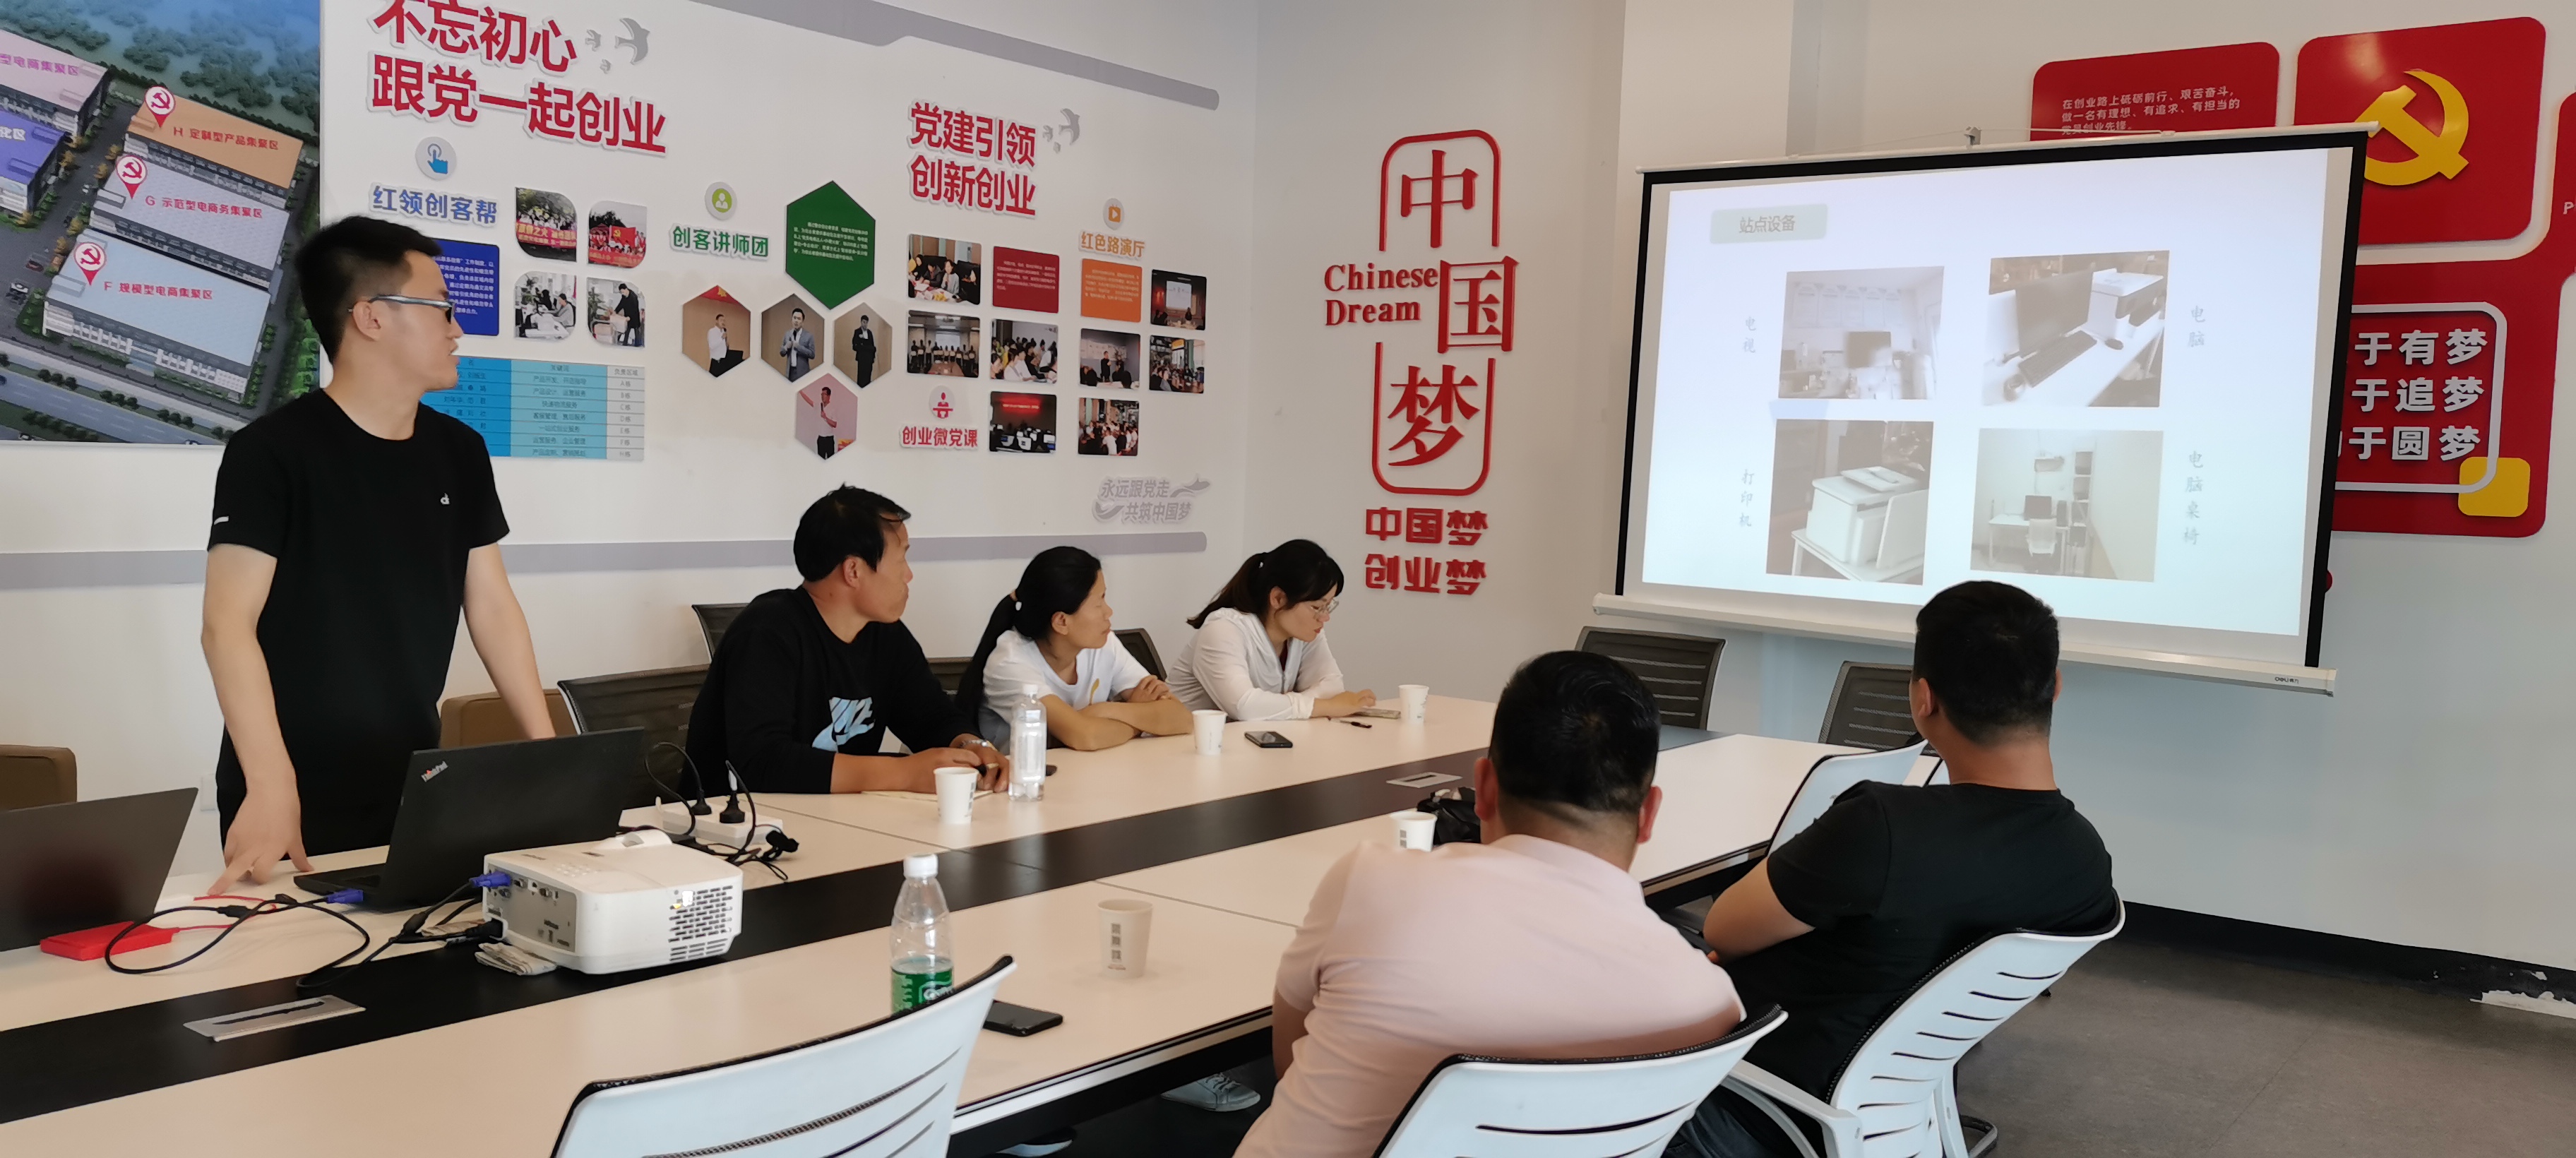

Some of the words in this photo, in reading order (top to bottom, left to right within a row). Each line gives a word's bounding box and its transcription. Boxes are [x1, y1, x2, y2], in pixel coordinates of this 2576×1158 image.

[373, 0, 578, 73] 不忘初心
[372, 54, 666, 153] 跟党一起创业
[173, 126, 184, 137] H
[910, 102, 1036, 167] 党建引领
[145, 195, 155, 205] G
[910, 155, 1036, 215] 创新创业
[373, 185, 497, 224] 红领创客帮
[1739, 214, 1795, 234] 站点设备
[673, 225, 768, 258] 创客讲师团
[1081, 231, 1145, 258] 红色路演厅
[104, 281, 112, 291] F
[1324, 262, 1439, 292] Chinese
[1325, 298, 1421, 326] Dream
[2354, 328, 2488, 366] 于有梦
[2351, 376, 2485, 413] 于追梦
[902, 426, 978, 448] 创业微党课
[2338, 426, 2481, 461] 于圆梦
[1100, 479, 1171, 499] 永远跟党走
[1121, 501, 1192, 522] 共筑中国梦
[1365, 506, 1489, 547] 中国梦
[1364, 552, 1486, 596] 创业梦
